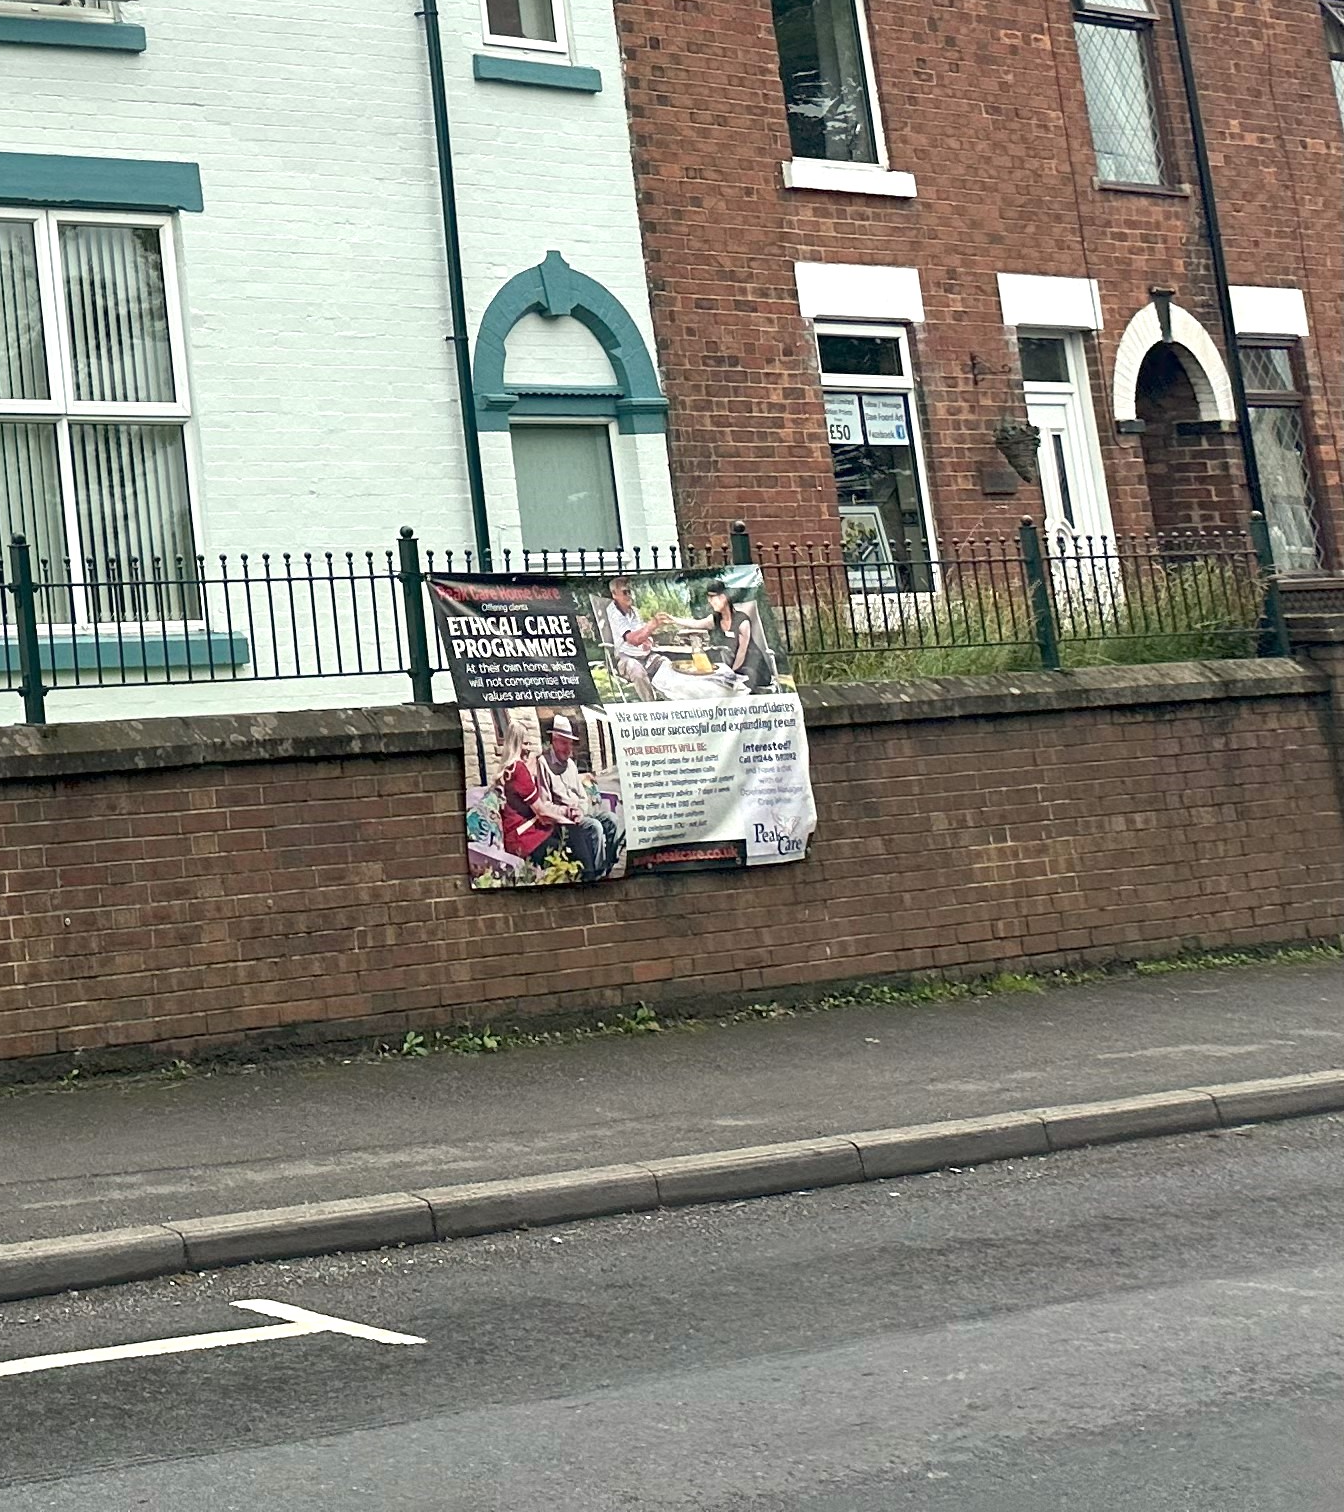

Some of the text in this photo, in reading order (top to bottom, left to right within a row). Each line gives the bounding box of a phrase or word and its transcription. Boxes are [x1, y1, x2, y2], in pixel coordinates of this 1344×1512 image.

[830, 424, 851, 440] £50
[439, 585, 561, 601] Peak Care Home Care
[482, 603, 508, 613] Offering
[446, 615, 572, 636] ETHICAL CARE
[451, 638, 577, 659] PROGRAMMES
[466, 663, 476, 674] At
[479, 662, 500, 673] their
[503, 664, 522, 672] own
[551, 662, 575, 672] which
[469, 675, 580, 689] will not compromise their
[483, 689, 575, 702] values and principles
[615, 702, 795, 723] We are now recruiting for new candidates
[620, 727, 630, 739] to
[632, 726, 649, 740] join
[651, 727, 665, 736] our
[667, 722, 710, 737] successful
[728, 719, 772, 732] expanding
[753, 823, 802, 855] Peak Care
